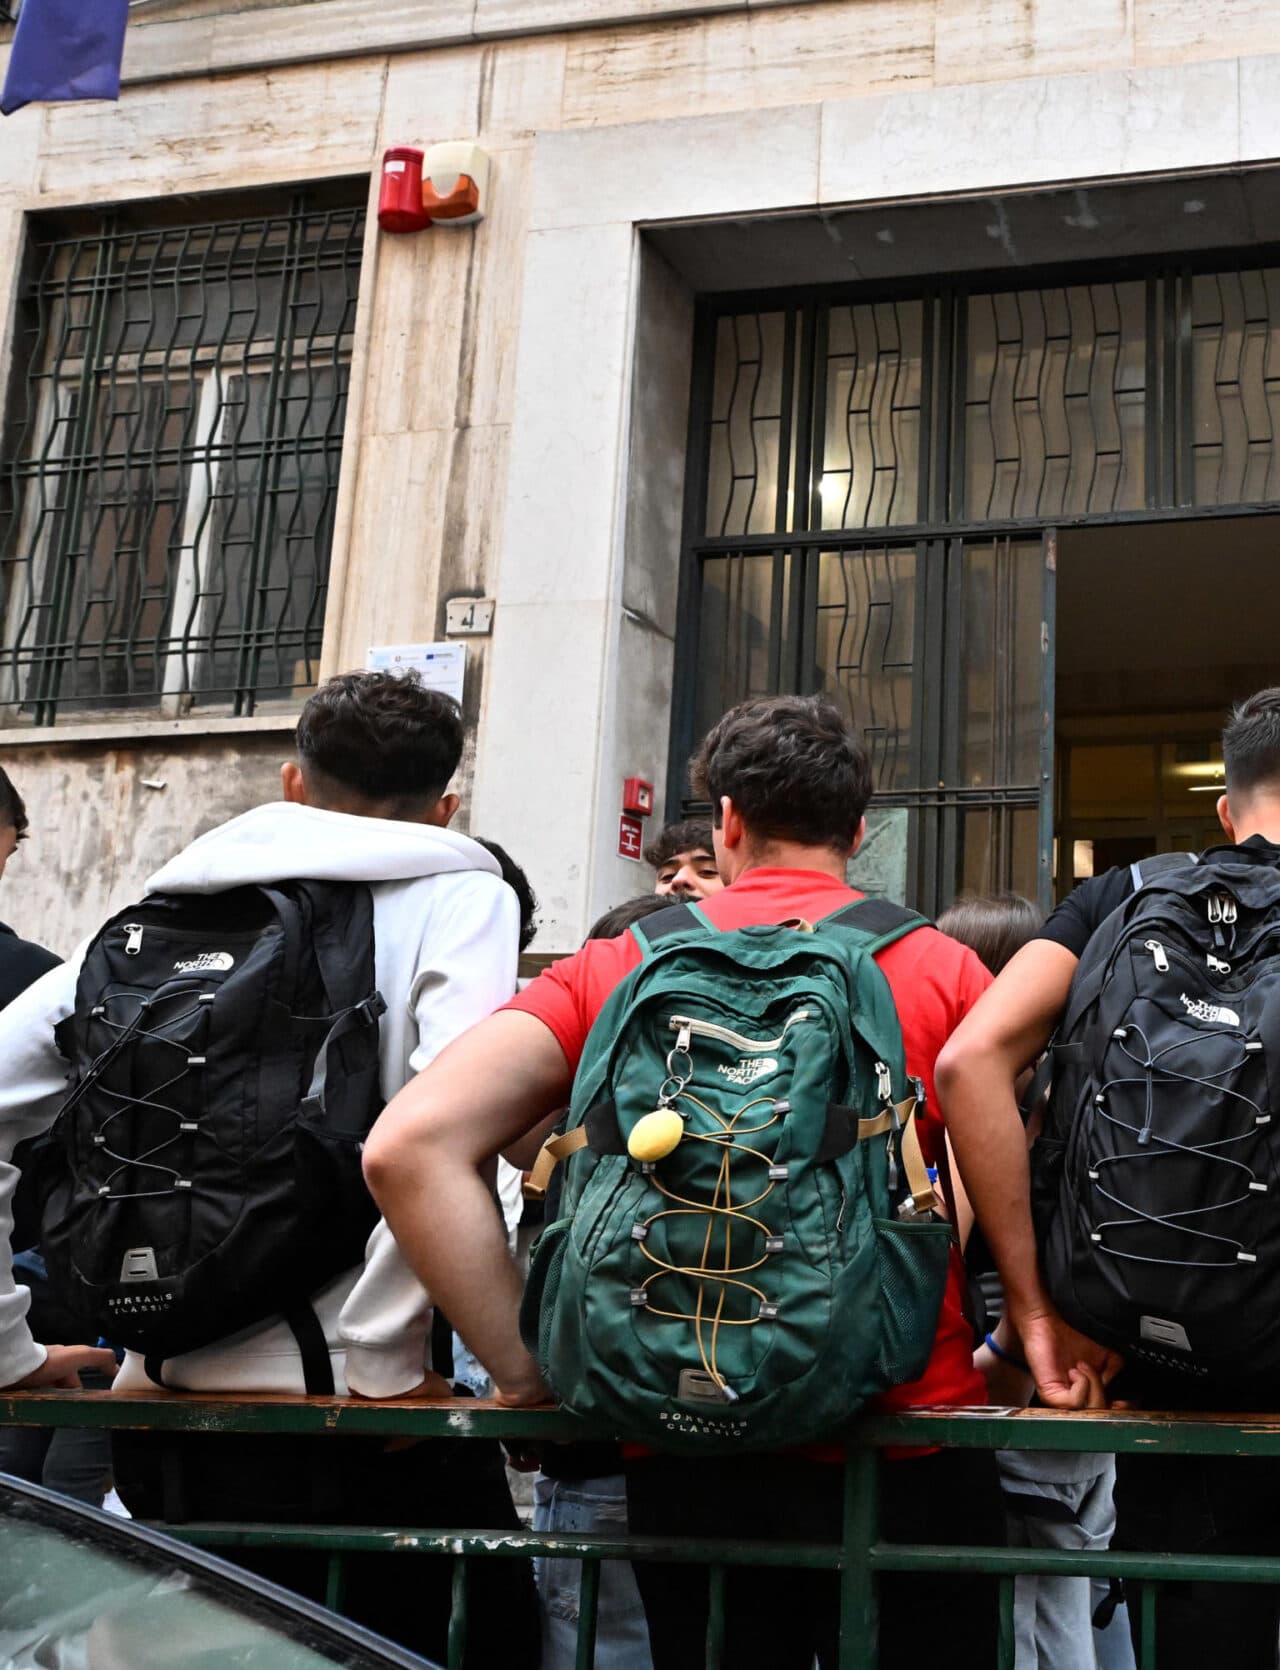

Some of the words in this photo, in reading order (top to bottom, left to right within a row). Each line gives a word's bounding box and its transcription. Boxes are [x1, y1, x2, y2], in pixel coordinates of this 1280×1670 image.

[461, 604, 475, 629] 4
[198, 953, 219, 961] THE
[739, 1058, 764, 1069] THE
